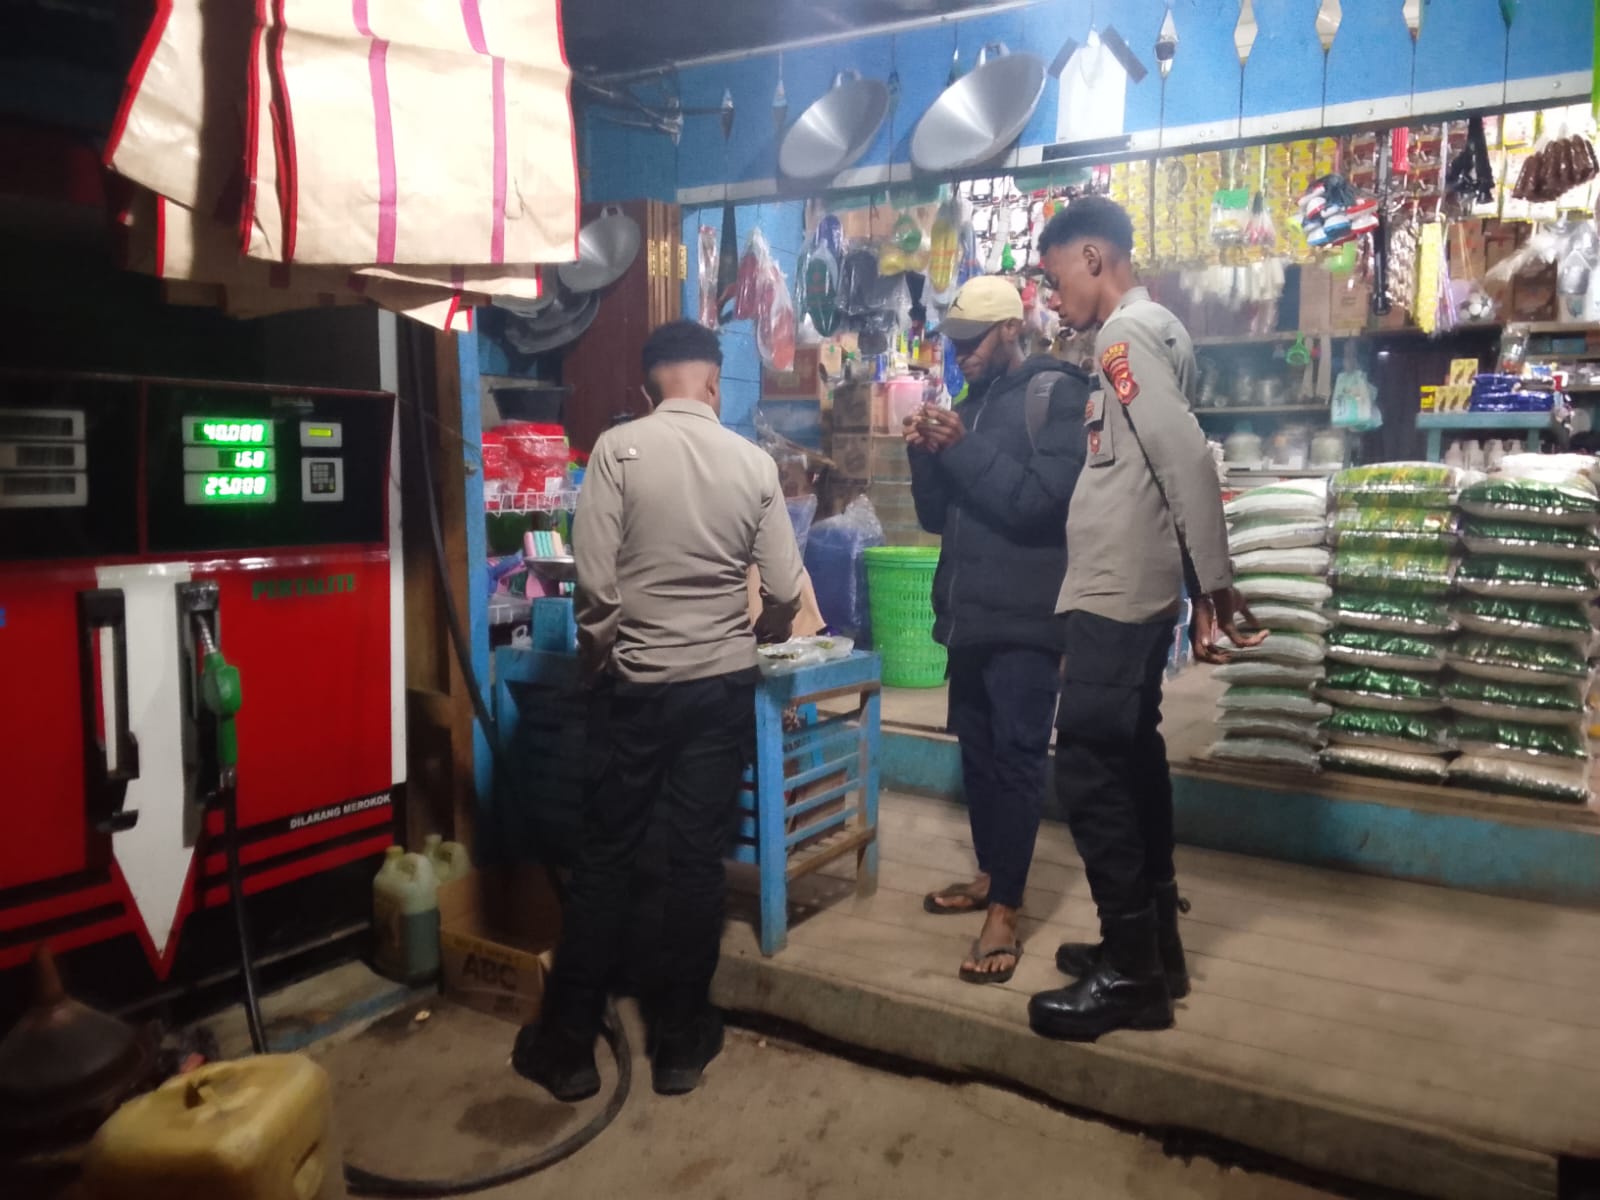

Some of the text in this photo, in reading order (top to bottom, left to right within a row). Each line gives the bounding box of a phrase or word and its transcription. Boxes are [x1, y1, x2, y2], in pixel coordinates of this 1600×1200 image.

[289, 793, 391, 830] DILARANG MEROKOK
[462, 951, 518, 991] ABC
